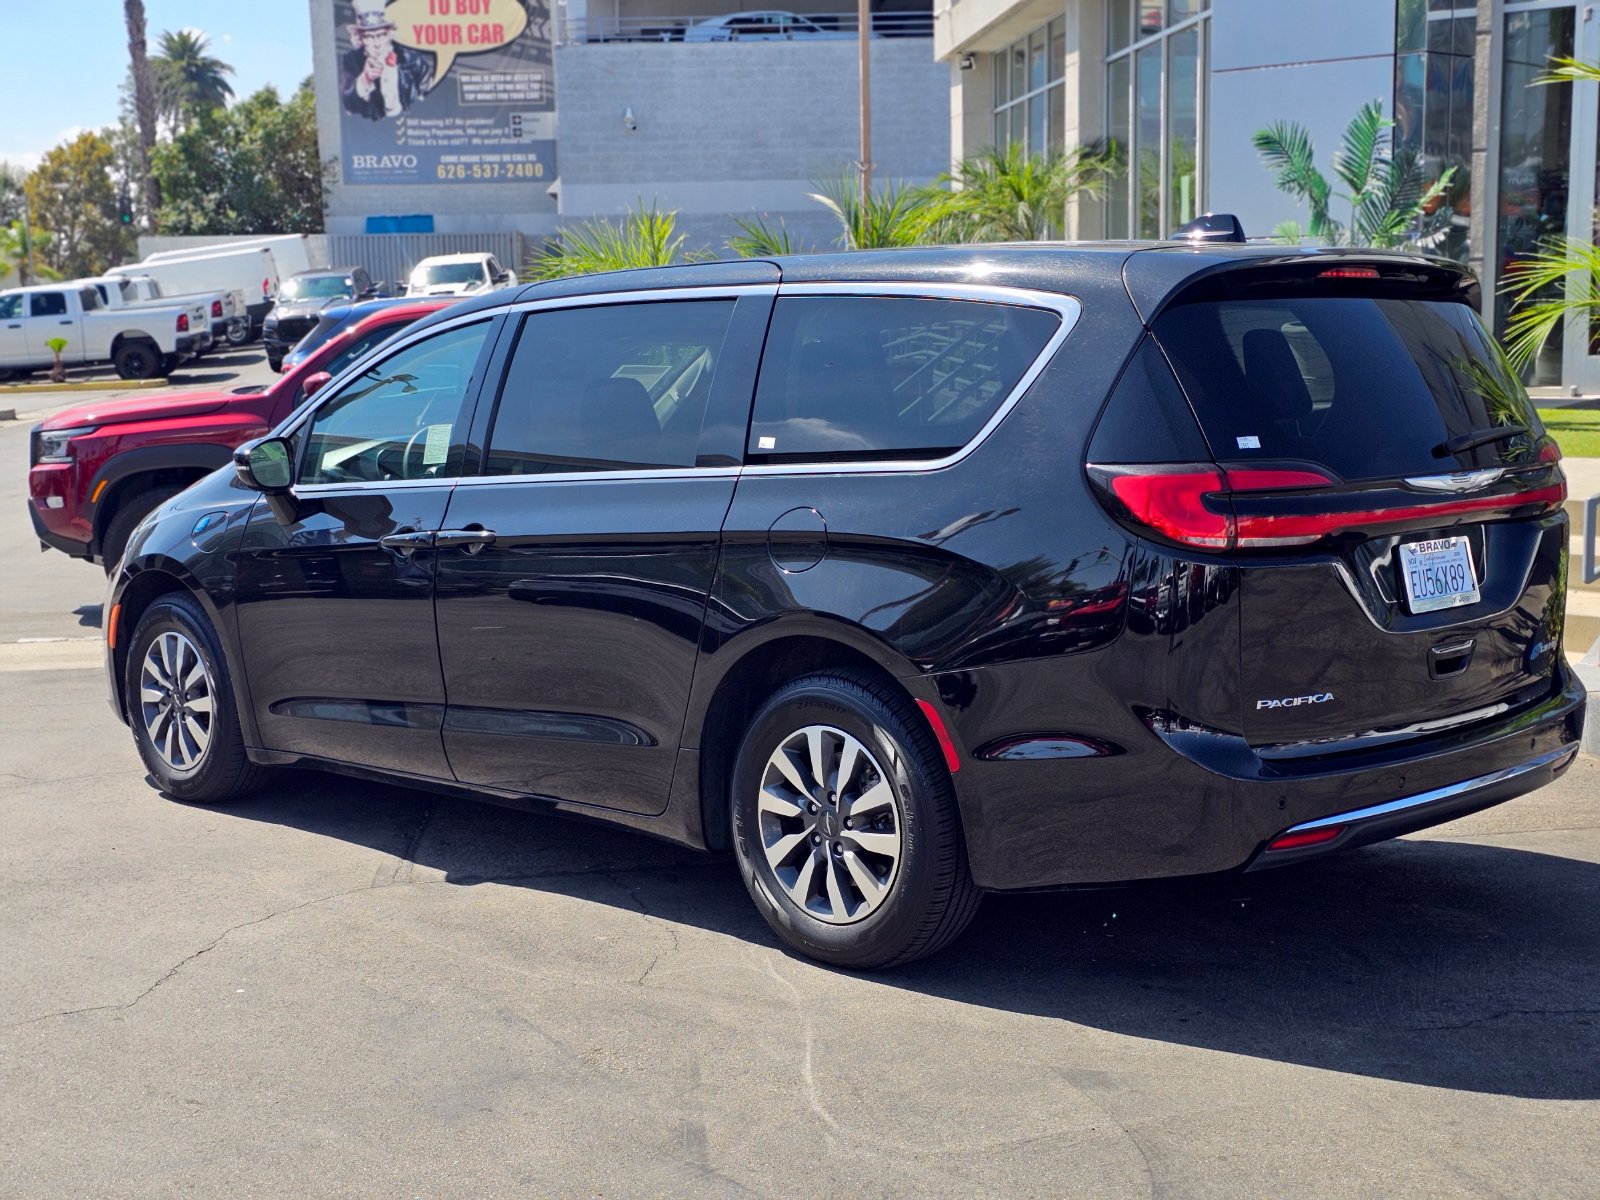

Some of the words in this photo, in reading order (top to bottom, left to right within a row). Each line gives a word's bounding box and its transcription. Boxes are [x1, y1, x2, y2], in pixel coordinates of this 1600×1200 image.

[429, 0, 450, 15] TO
[455, 0, 491, 15] BUY
[413, 24, 461, 44] YOUR
[467, 23, 504, 44] CAR
[407, 128, 430, 137] Making
[466, 127, 477, 135] We
[407, 138, 425, 146] Think
[471, 137, 482, 145] We
[352, 154, 418, 169] BRAVO
[512, 153, 527, 161] CALL
[437, 163, 543, 179] 626-537-2400
[1419, 540, 1450, 553] BRAVO
[1410, 563, 1465, 599] EU56X89
[1256, 692, 1335, 710] PACIFICA
